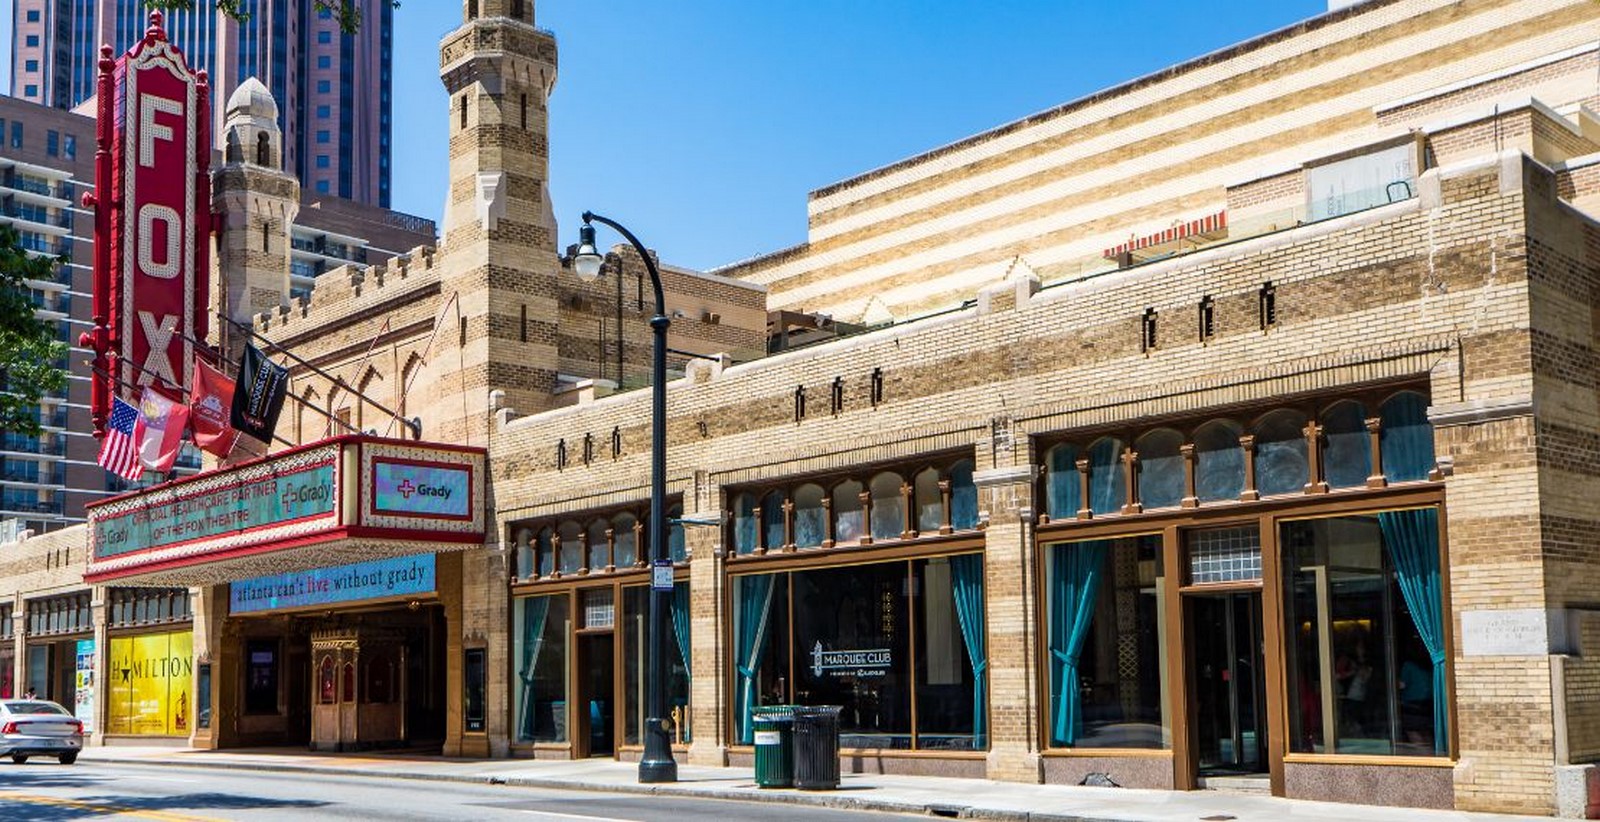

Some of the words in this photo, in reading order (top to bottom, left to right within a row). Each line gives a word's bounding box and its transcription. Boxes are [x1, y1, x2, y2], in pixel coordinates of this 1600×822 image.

[137, 92, 184, 389] FOX
[170, 491, 229, 517] HEALTHCARE
[231, 481, 278, 502] PARTNER
[299, 484, 331, 502] Grady
[417, 484, 452, 500] Grady
[153, 527, 165, 540] OF
[167, 523, 184, 537] THE
[186, 519, 204, 533] FOX
[206, 509, 249, 528] THEATRE
[107, 528, 129, 546] Grady
[237, 583, 273, 602] atlanta
[277, 577, 304, 596] can't
[307, 576, 329, 593] live
[334, 569, 382, 590] without
[387, 561, 425, 590] grady
[824, 654, 866, 665] MARQUEE
[867, 652, 892, 663] CLUB
